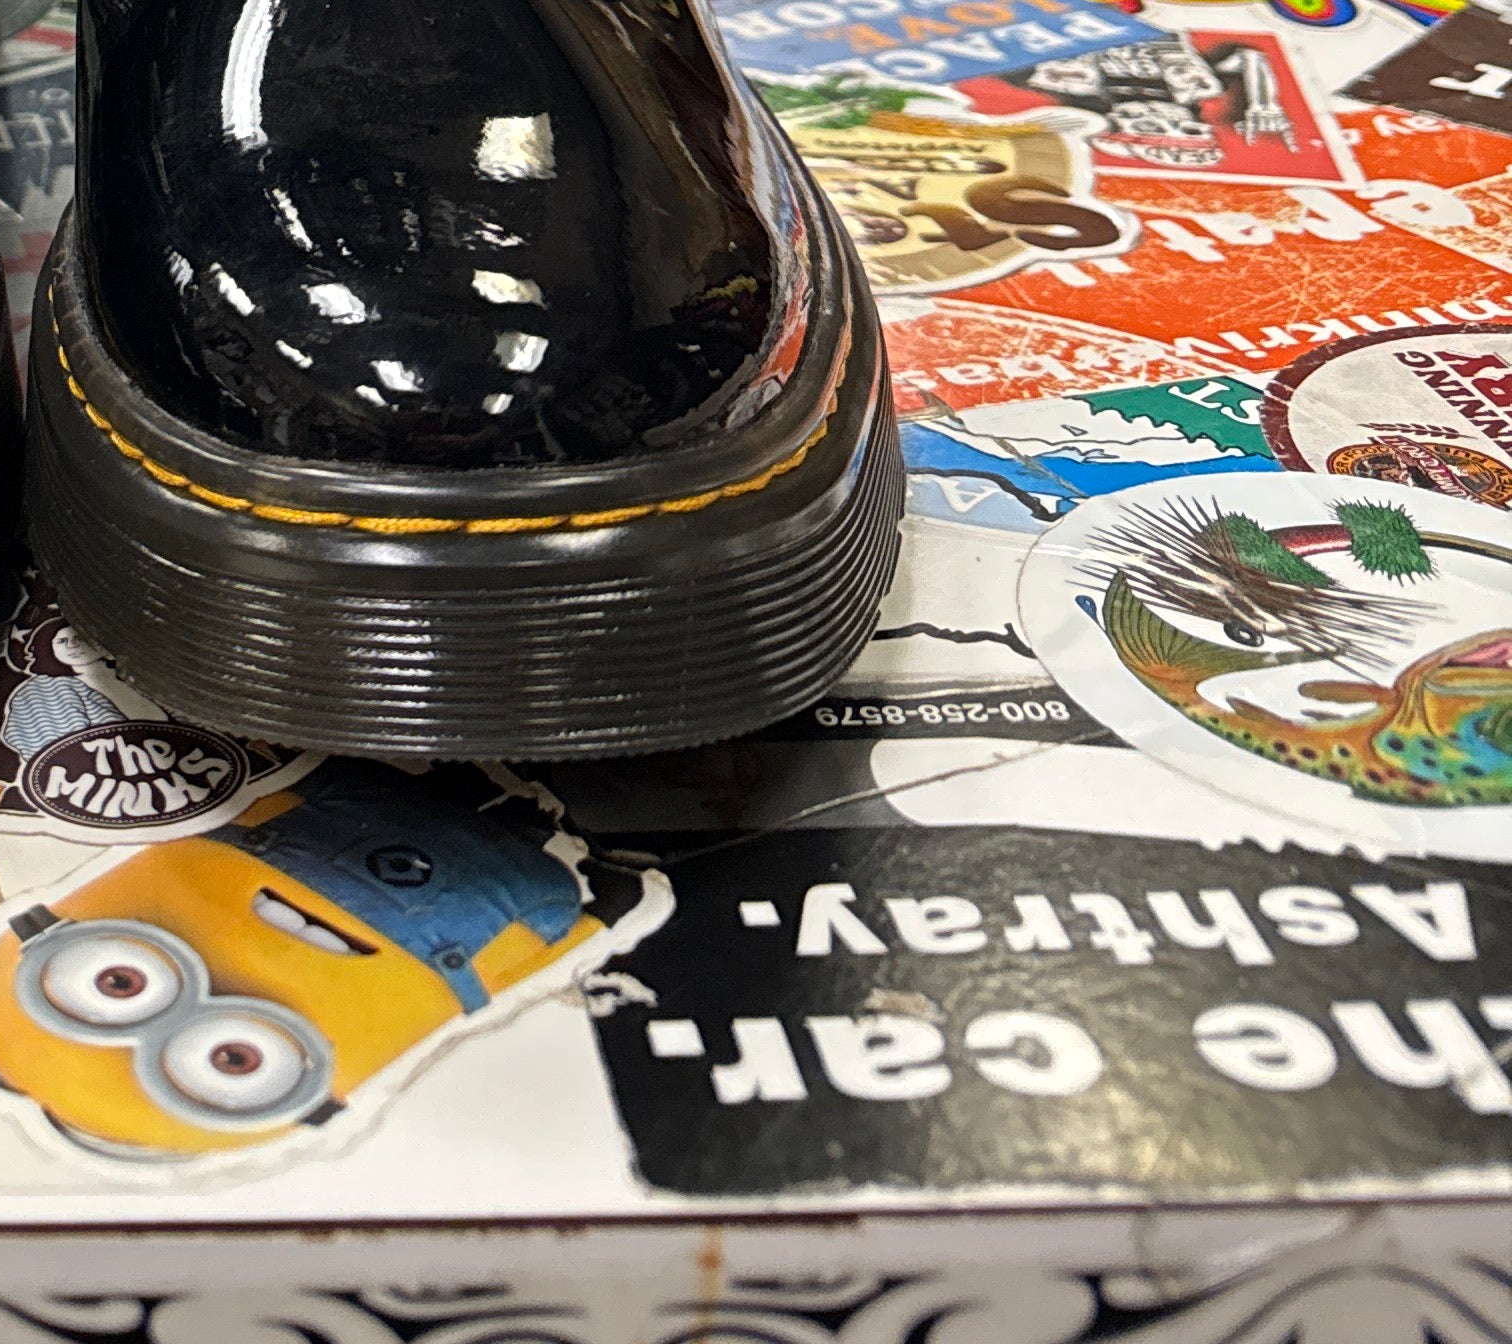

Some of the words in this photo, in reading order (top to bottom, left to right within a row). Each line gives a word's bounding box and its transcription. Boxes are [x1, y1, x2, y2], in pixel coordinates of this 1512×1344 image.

[1168, 378, 1264, 426] ST
[814, 700, 1071, 728] 800-258-8579
[44, 747, 232, 818] MINKS
[82, 734, 177, 777] The
[739, 882, 1478, 967] Ashtray.
[646, 1008, 1103, 1104] car.
[1192, 997, 1512, 1115] he
